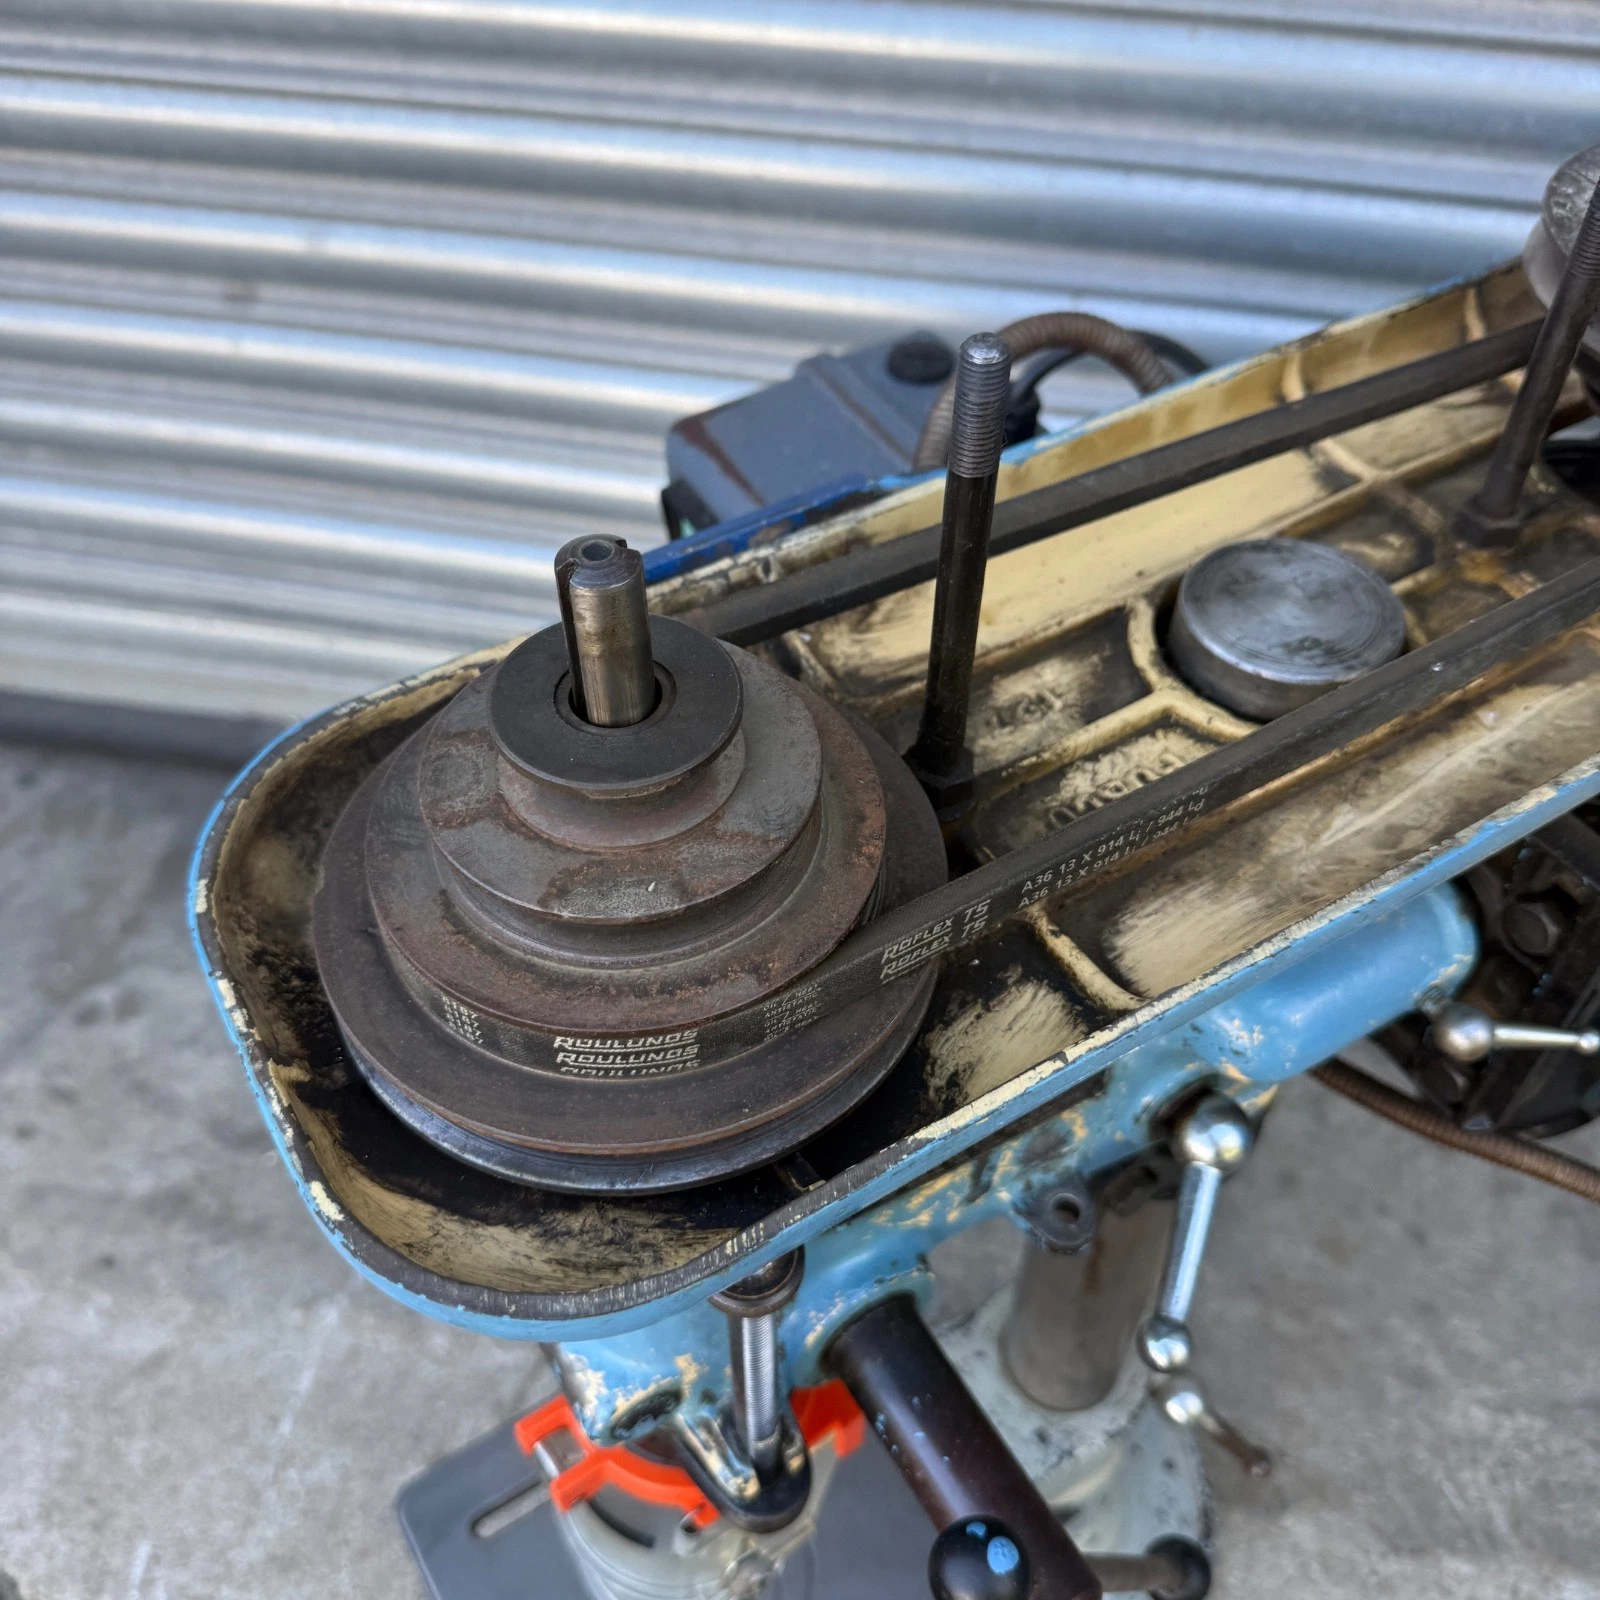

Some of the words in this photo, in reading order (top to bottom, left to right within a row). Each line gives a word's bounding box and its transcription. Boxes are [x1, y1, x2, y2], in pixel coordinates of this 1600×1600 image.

[1021, 869, 1054, 894] A36
[1059, 858, 1076, 875] 13
[1097, 835, 1124, 857] 914
[1158, 805, 1184, 827] 944
[1188, 798, 1205, 812] Ld
[1017, 886, 1049, 910] A36
[1055, 874, 1073, 889] 13
[1092, 851, 1120, 872] 914
[879, 932, 953, 980] ROFLEX
[881, 917, 955, 965] ROFLEX
[553, 1028, 700, 1052] ROULUNDS
[556, 1043, 701, 1068] ROULUNDS
